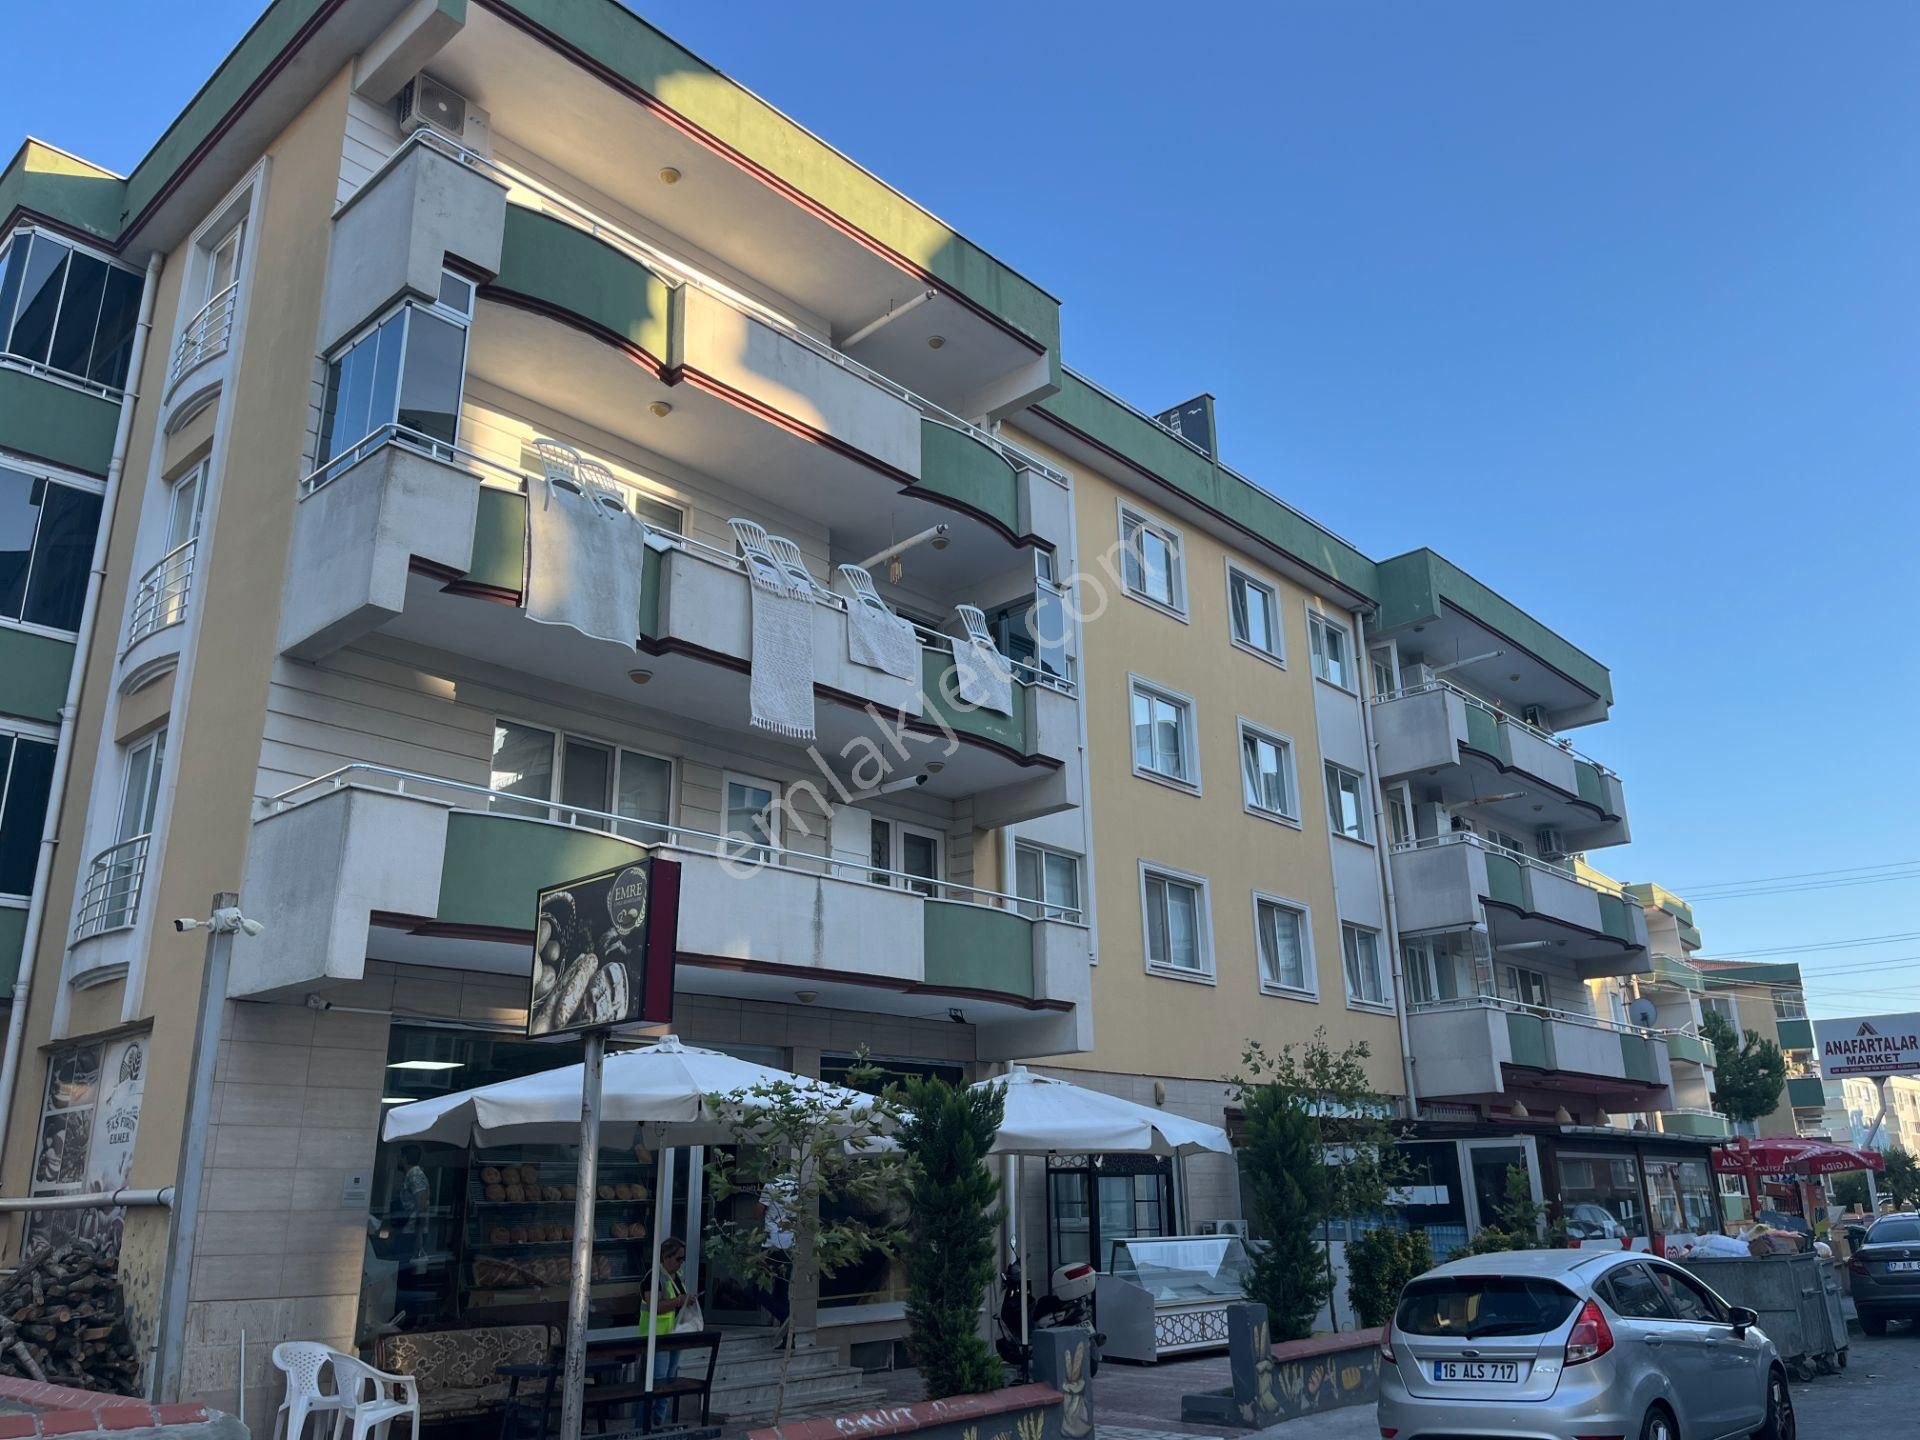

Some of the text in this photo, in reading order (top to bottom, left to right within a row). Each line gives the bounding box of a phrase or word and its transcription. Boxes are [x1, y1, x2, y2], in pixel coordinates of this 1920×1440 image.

[615, 882, 643, 901] EMRE
[1825, 1035, 1919, 1056] ANAFARTALAR
[1846, 1053, 1901, 1066] MARKET
[1443, 1364, 1514, 1379] 16 ALS 717
